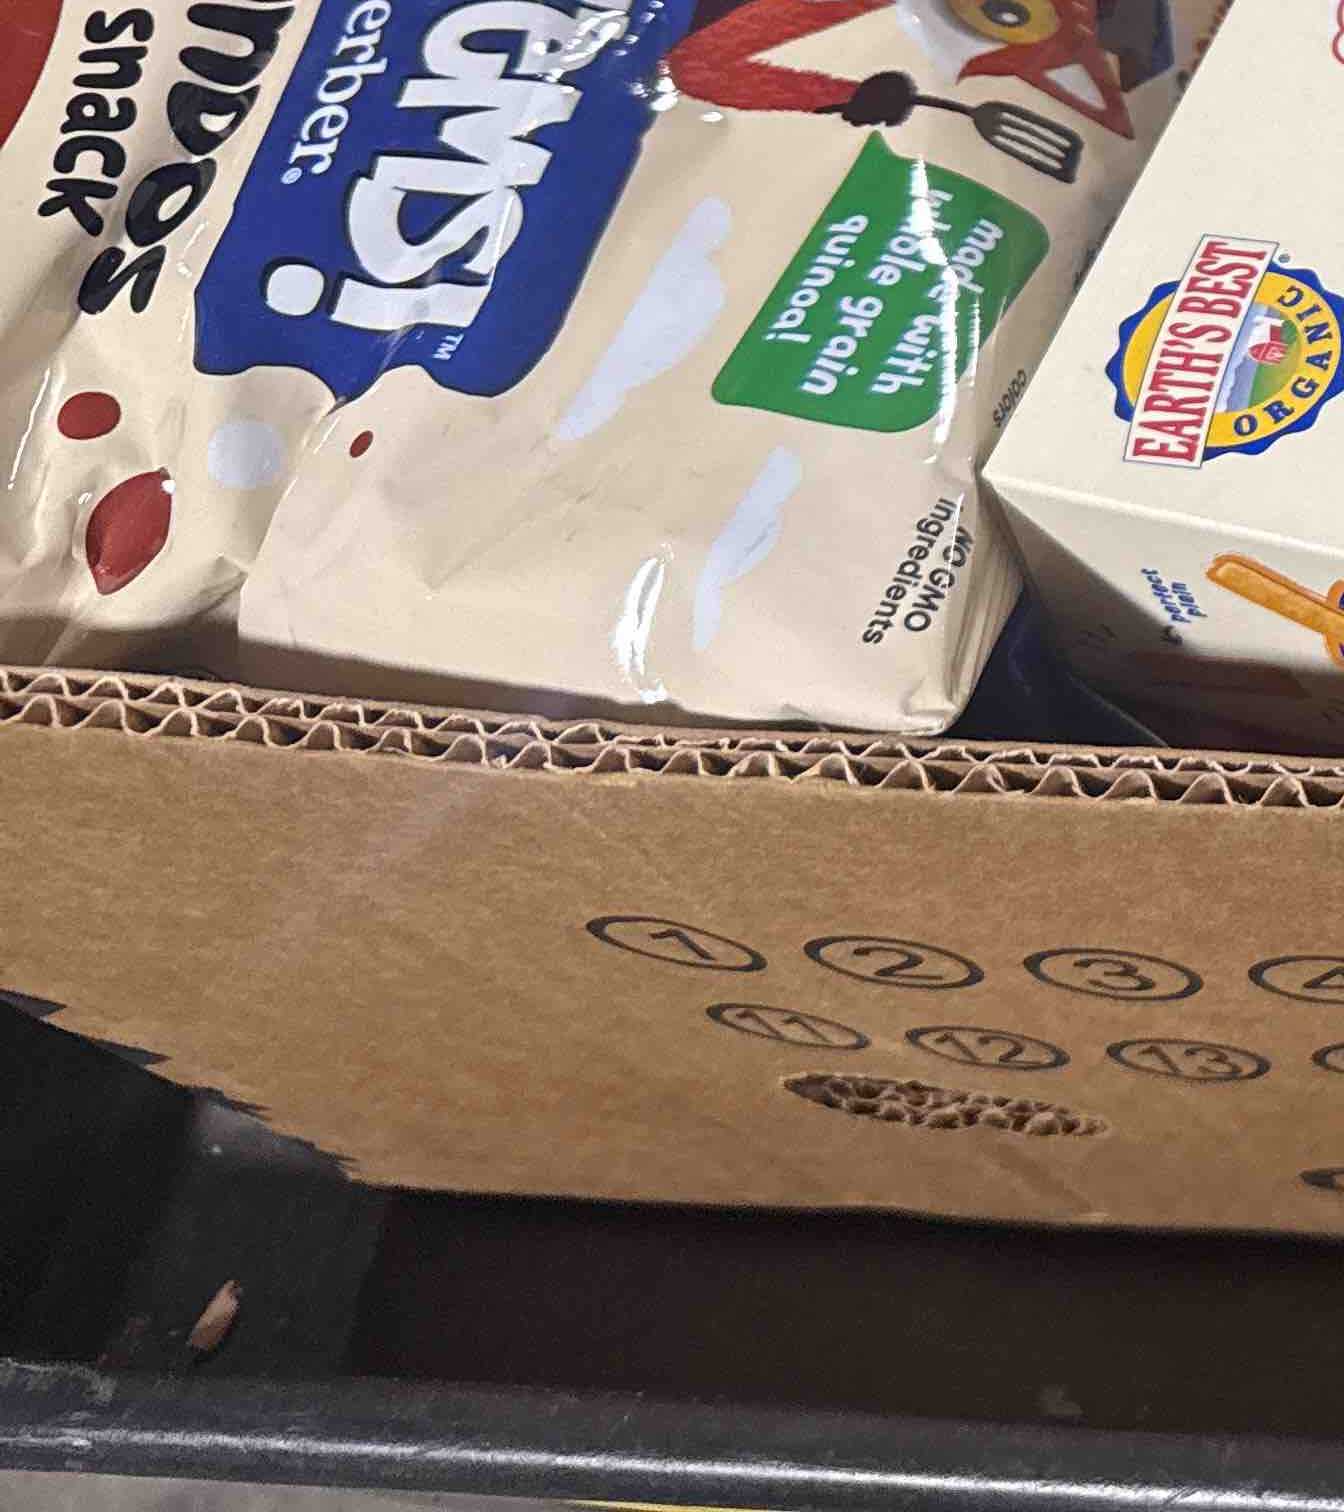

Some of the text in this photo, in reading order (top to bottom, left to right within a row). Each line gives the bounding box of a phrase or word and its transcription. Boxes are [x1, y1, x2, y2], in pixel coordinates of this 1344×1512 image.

[764, 214, 869, 345] quinoa!
[803, 294, 884, 397] grain
[872, 312, 943, 396] with
[1133, 241, 1267, 462] EARTH'S BEST
[1233, 286, 1332, 437] ORGANIC
[863, 497, 963, 645] ingredients
[903, 568, 955, 633] GMO
[730, 1008, 845, 1046] 11
[936, 1031, 1042, 1065] 12
[1138, 1044, 1244, 1076] 13
